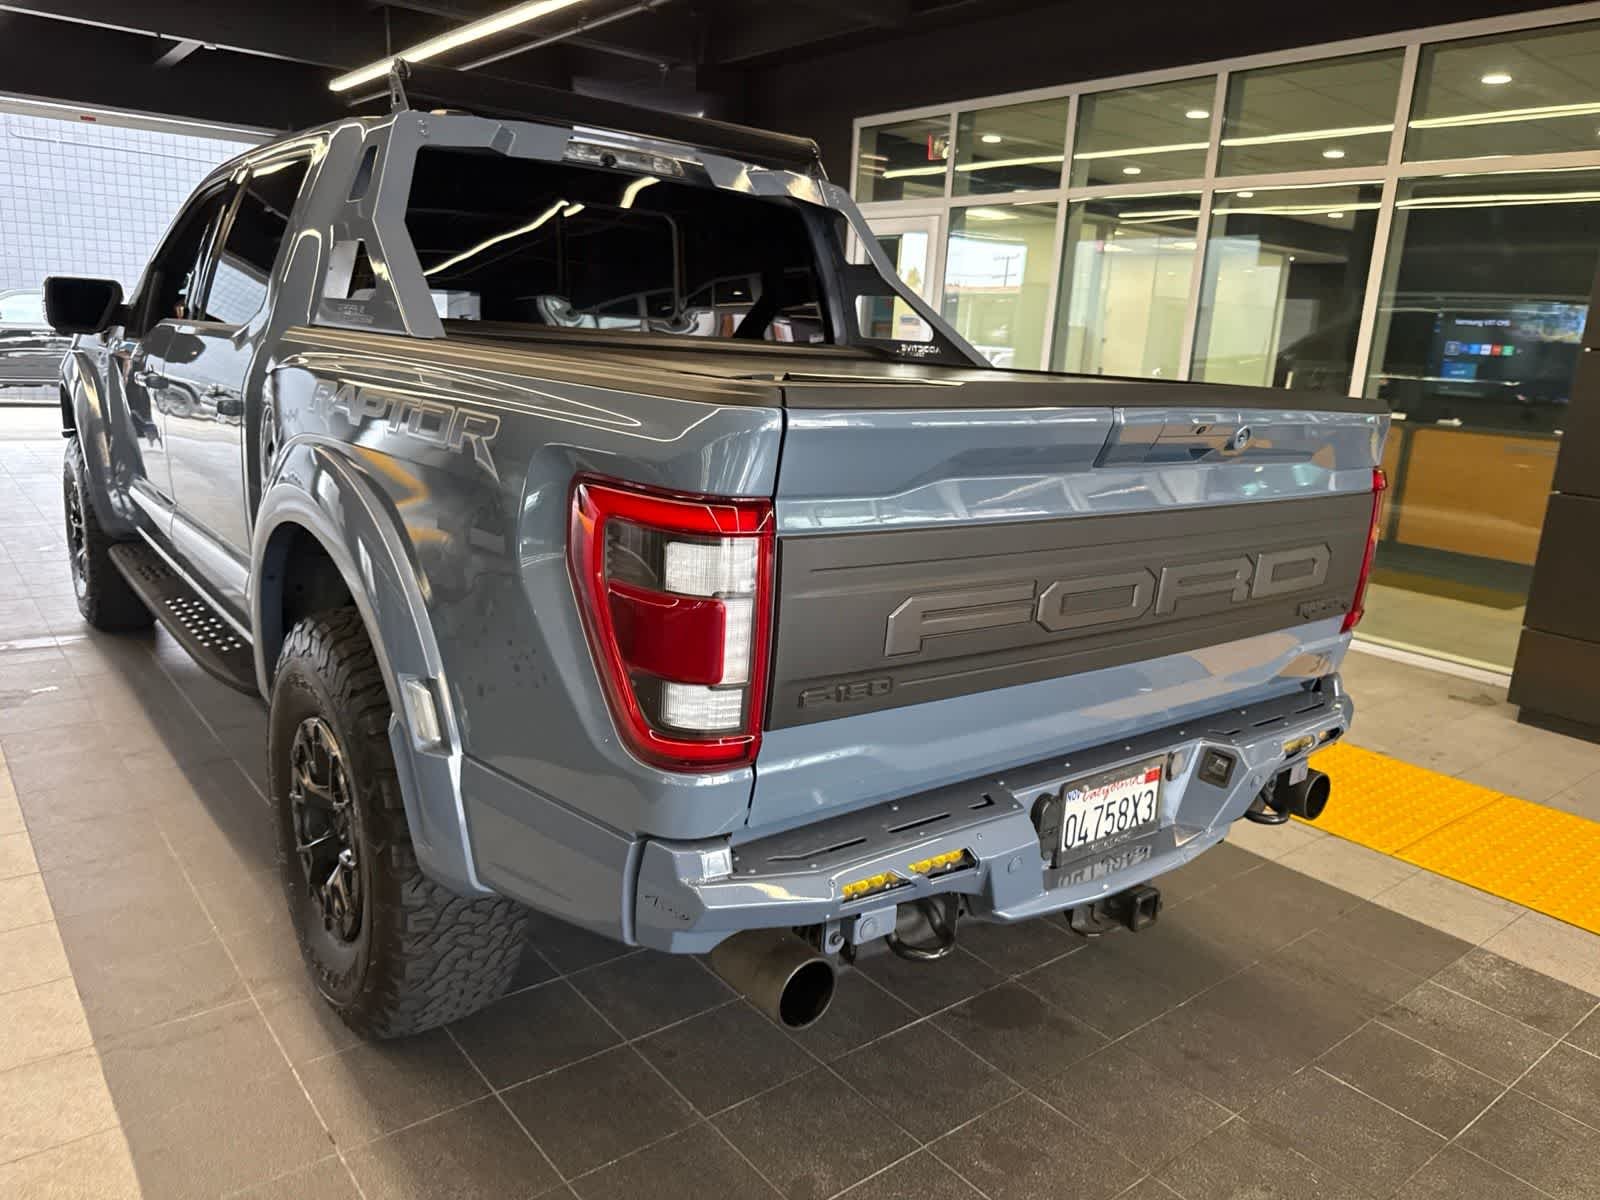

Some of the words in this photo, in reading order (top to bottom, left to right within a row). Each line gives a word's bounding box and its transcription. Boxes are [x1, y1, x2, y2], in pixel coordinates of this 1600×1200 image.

[309, 378, 501, 486] RAPTOR
[884, 543, 1332, 657] FORD
[1064, 789, 1154, 850] 04758X3
